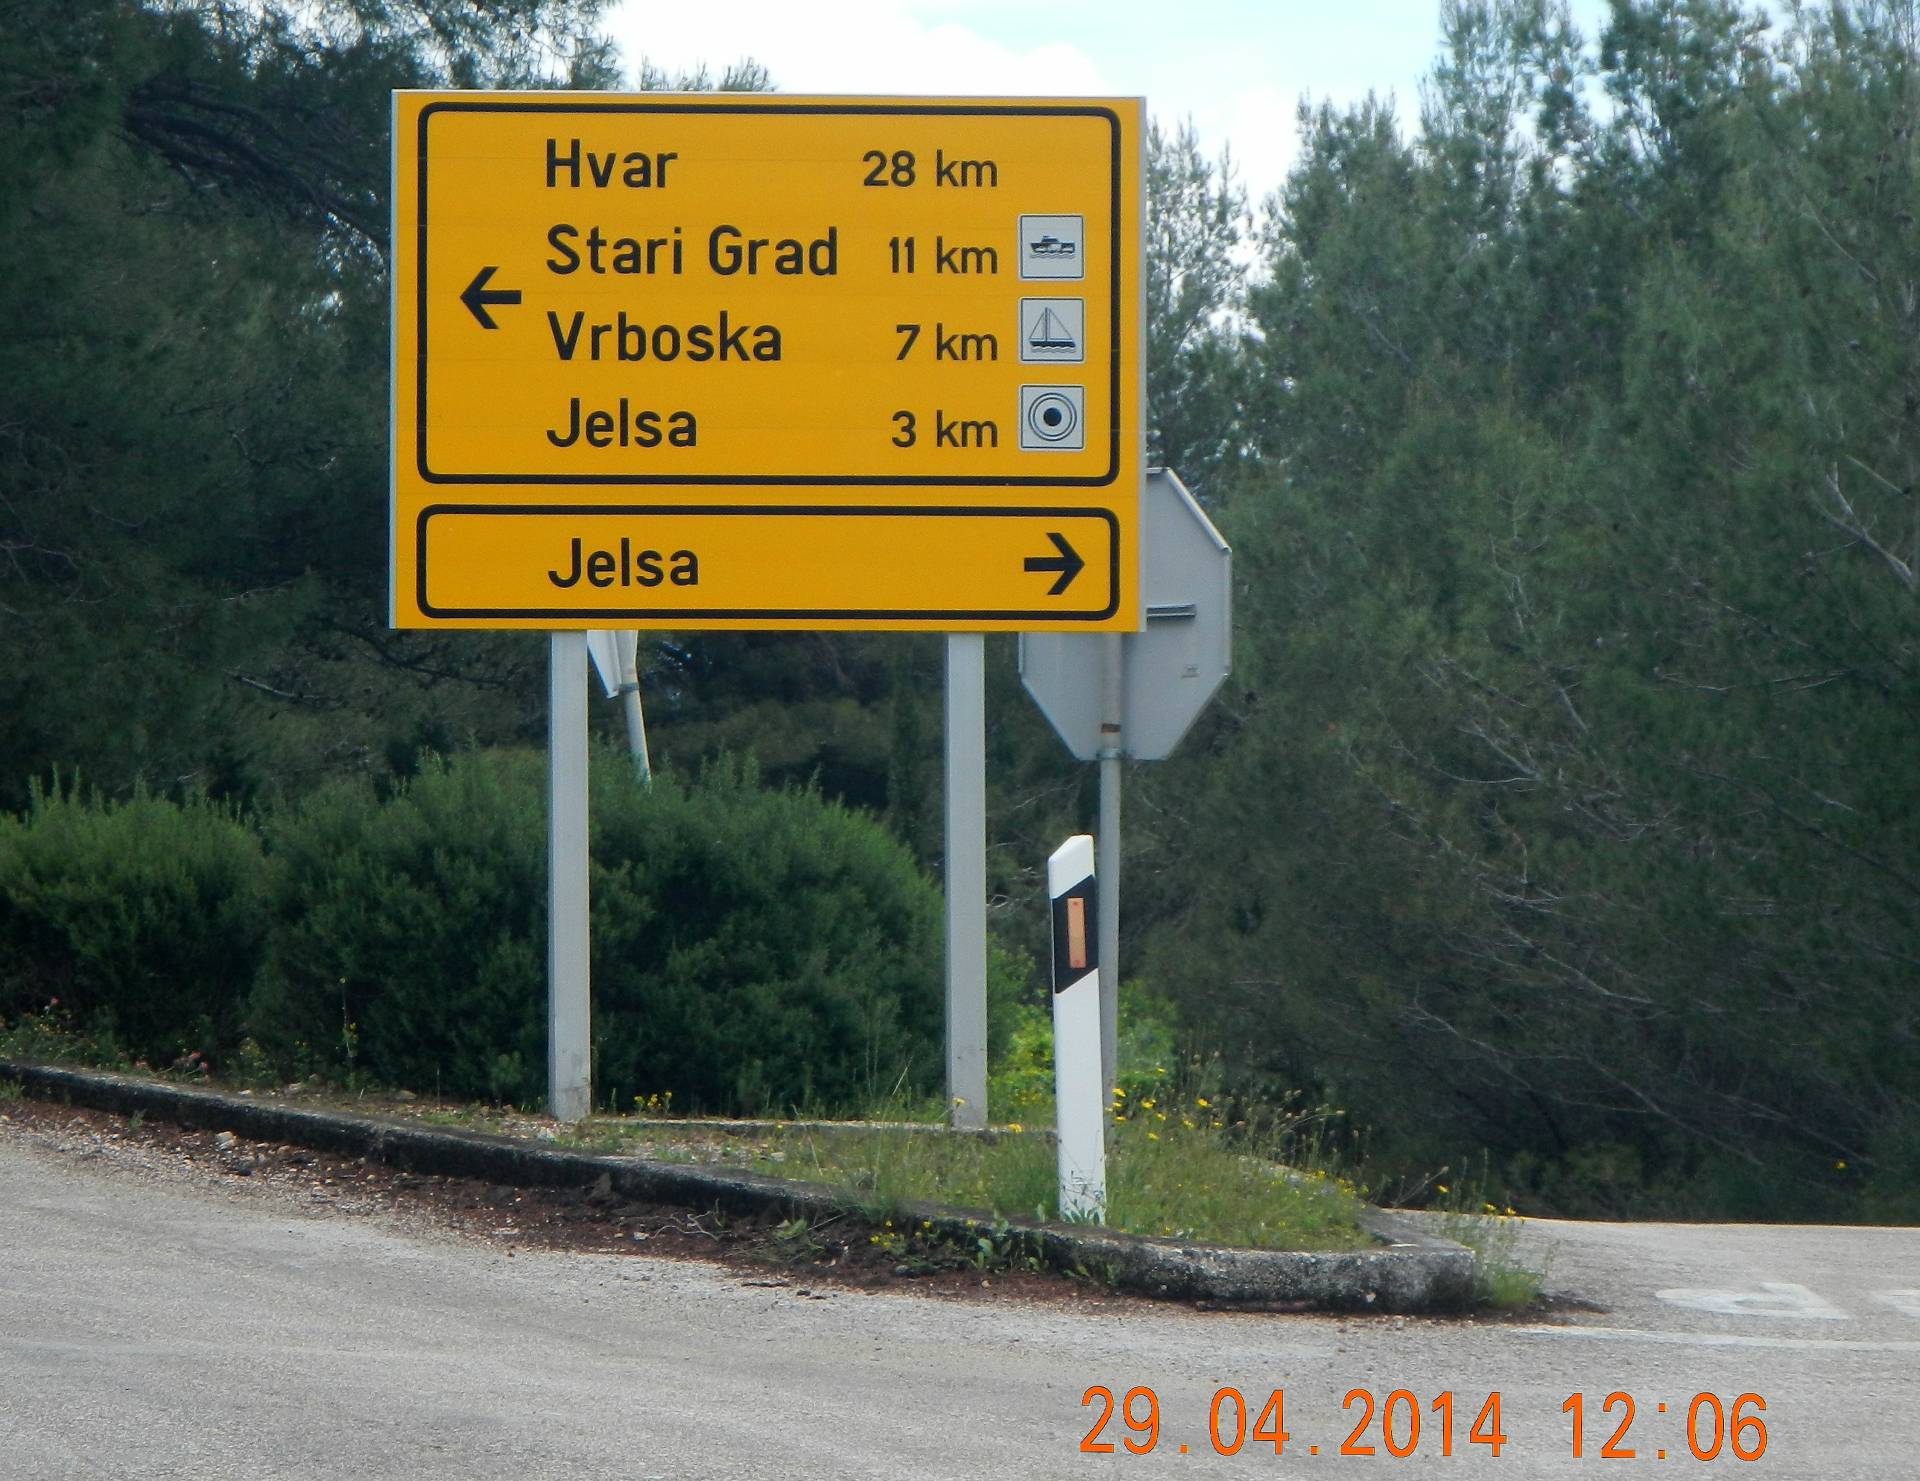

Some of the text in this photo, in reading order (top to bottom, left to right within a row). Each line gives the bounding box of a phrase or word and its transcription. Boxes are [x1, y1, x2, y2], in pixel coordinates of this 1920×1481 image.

[547, 139, 997, 188] Hvar 28 km
[547, 224, 997, 276] Stari Grad 11 km
[547, 311, 997, 361] Vrboska 7 km
[547, 398, 997, 447] Jelsa 3 km
[548, 538, 698, 588] Jelsa
